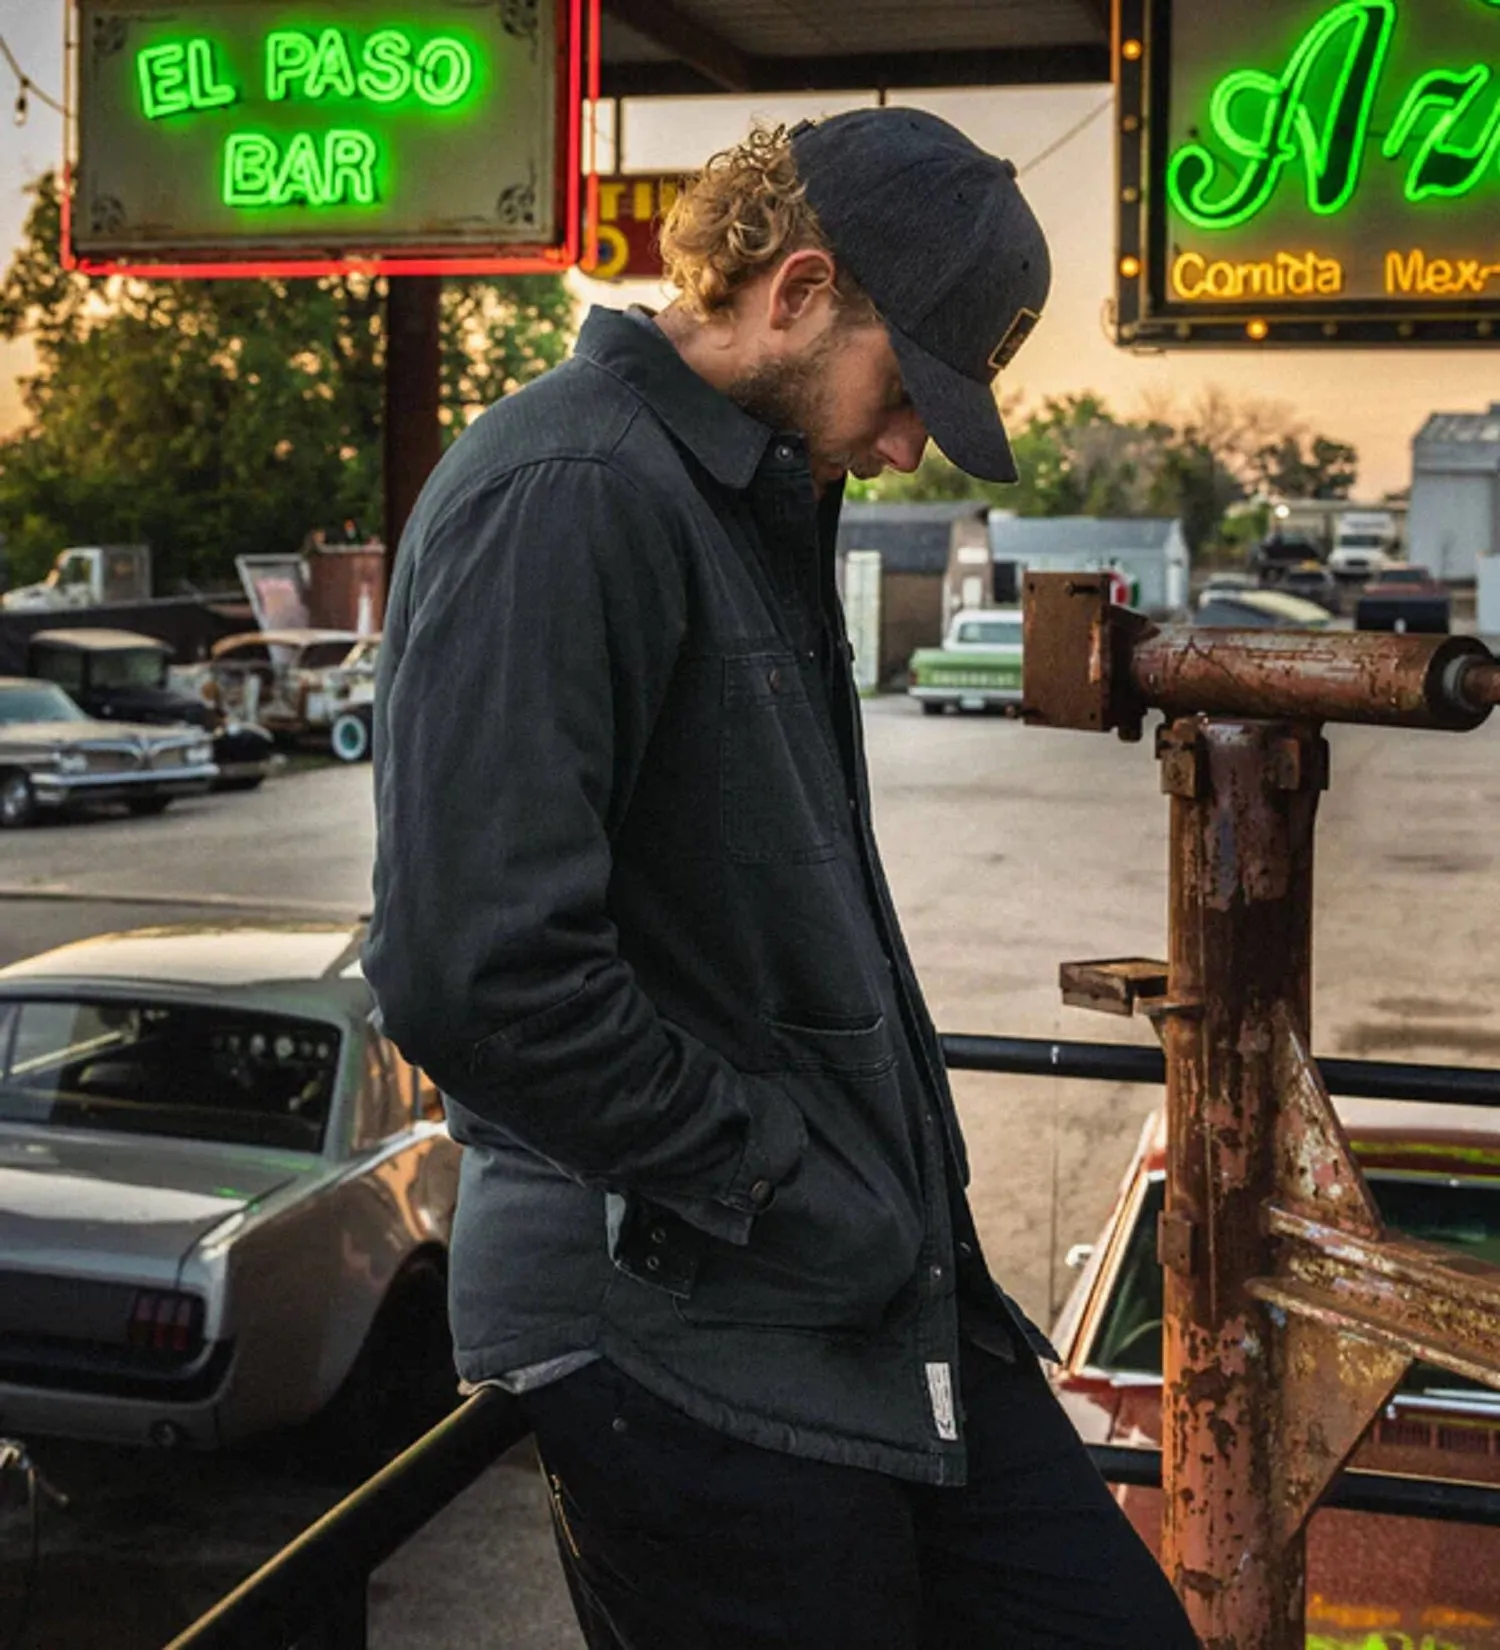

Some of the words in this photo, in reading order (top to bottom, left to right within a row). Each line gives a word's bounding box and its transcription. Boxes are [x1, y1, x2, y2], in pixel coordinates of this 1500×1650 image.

[137, 39, 236, 118] EL
[265, 28, 472, 106] PASO
[1167, 0, 1500, 228] Az
[224, 129, 376, 206] BAR
[1172, 252, 1342, 299] Comida
